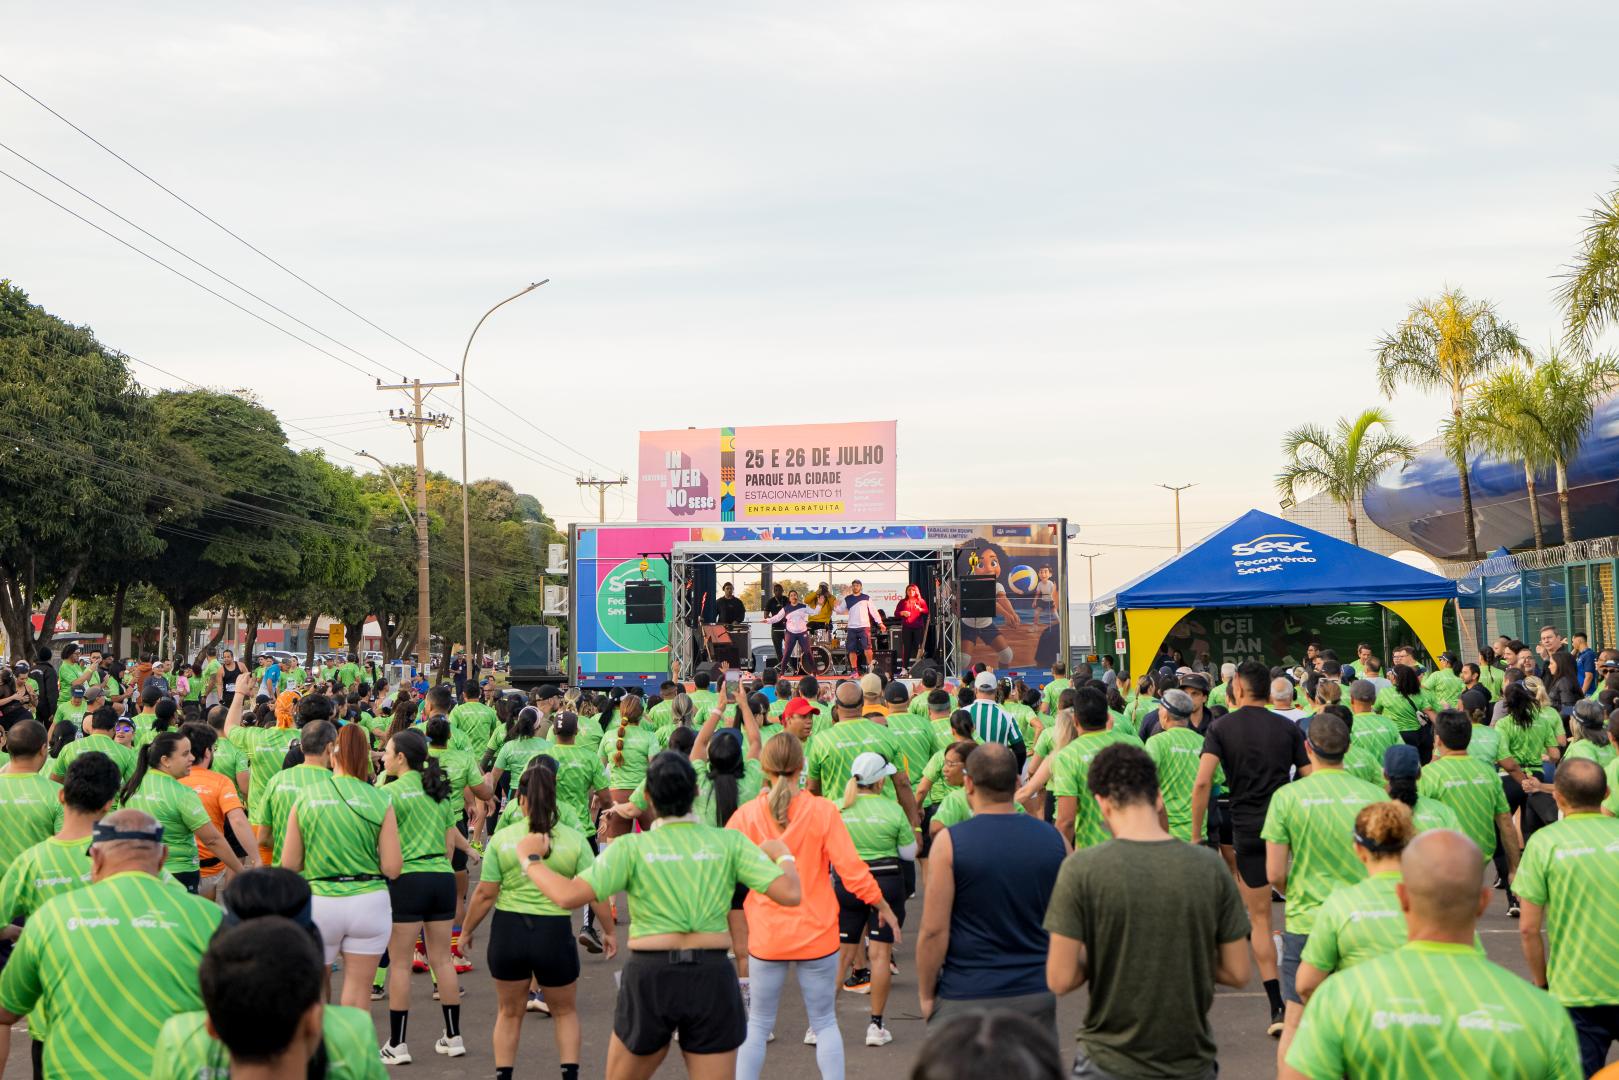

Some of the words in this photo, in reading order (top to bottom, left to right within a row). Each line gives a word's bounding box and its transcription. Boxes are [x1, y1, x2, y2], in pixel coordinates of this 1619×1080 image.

[745, 449, 764, 469] 25
[771, 448, 780, 468] E
[785, 447, 806, 467] 26
[812, 447, 831, 467] DE
[836, 444, 884, 466] JULHO
[671, 468, 701, 488] VER
[745, 472, 784, 487] PARQUE
[787, 472, 802, 486] DA
[805, 471, 841, 485] CIDADE
[744, 489, 833, 500] ESTACIONAMENTO
[748, 505, 790, 513] ENTRADA
[794, 504, 840, 512] GRATUITA
[1234, 556, 1317, 567] Fecomércio
[1237, 564, 1284, 575] Senac
